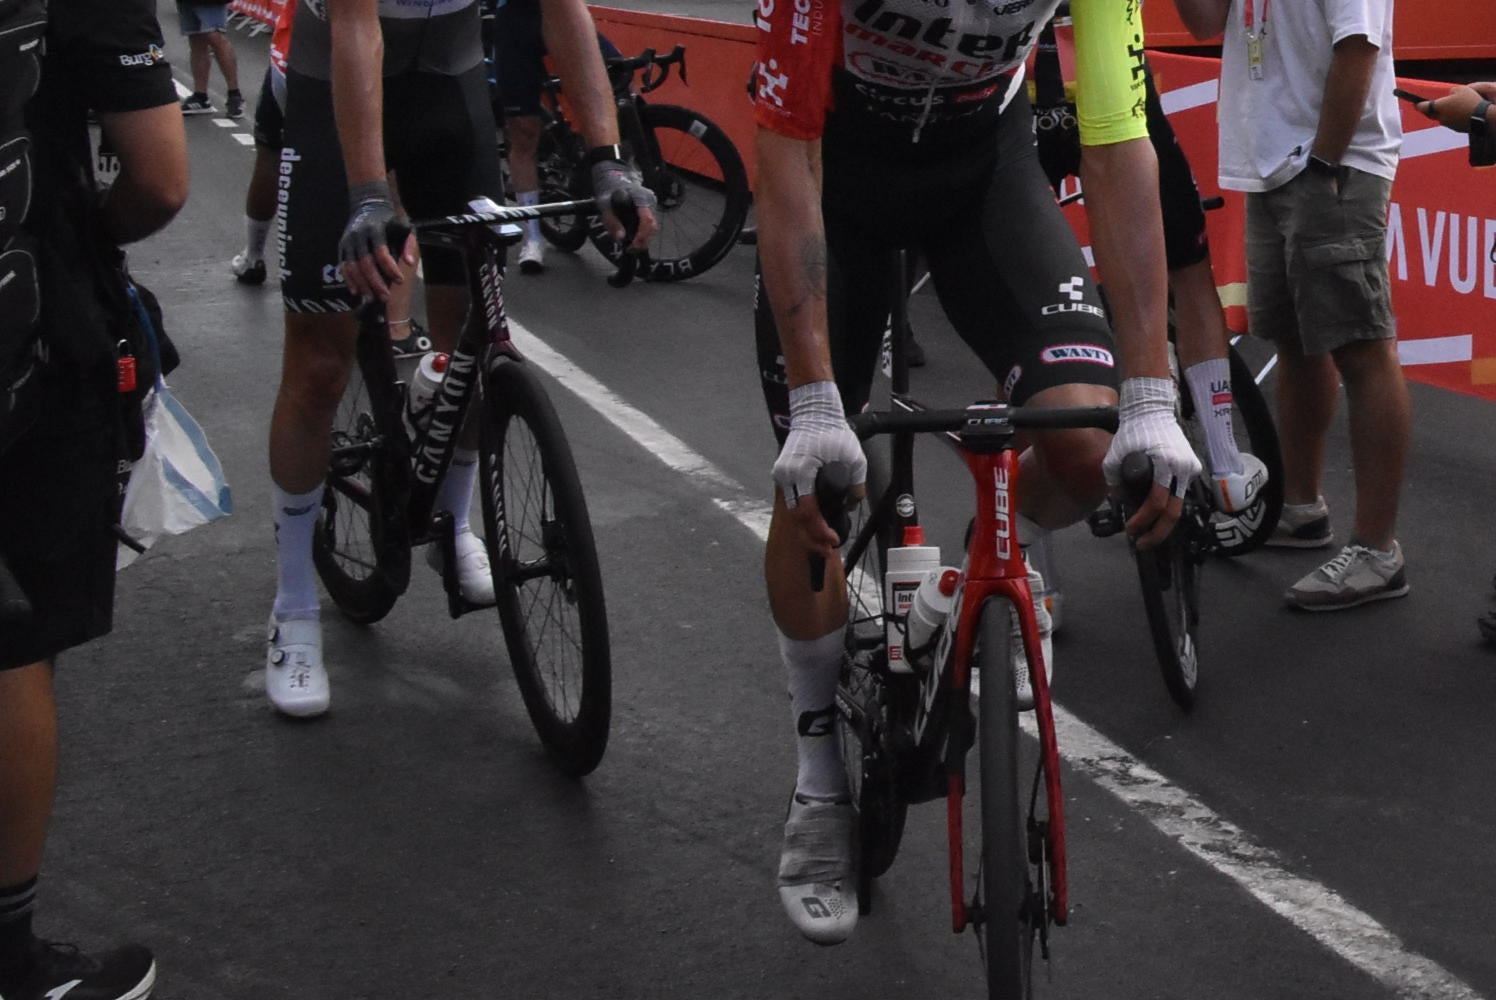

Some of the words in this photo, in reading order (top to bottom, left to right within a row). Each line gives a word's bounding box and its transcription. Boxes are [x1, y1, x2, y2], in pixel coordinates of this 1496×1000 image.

[277, 147, 302, 281] deceuninck
[1041, 303, 1104, 318] CUBE
[1050, 347, 1110, 362] WANTY
[416, 350, 476, 484] CANYON
[994, 466, 1011, 560] CUBE
